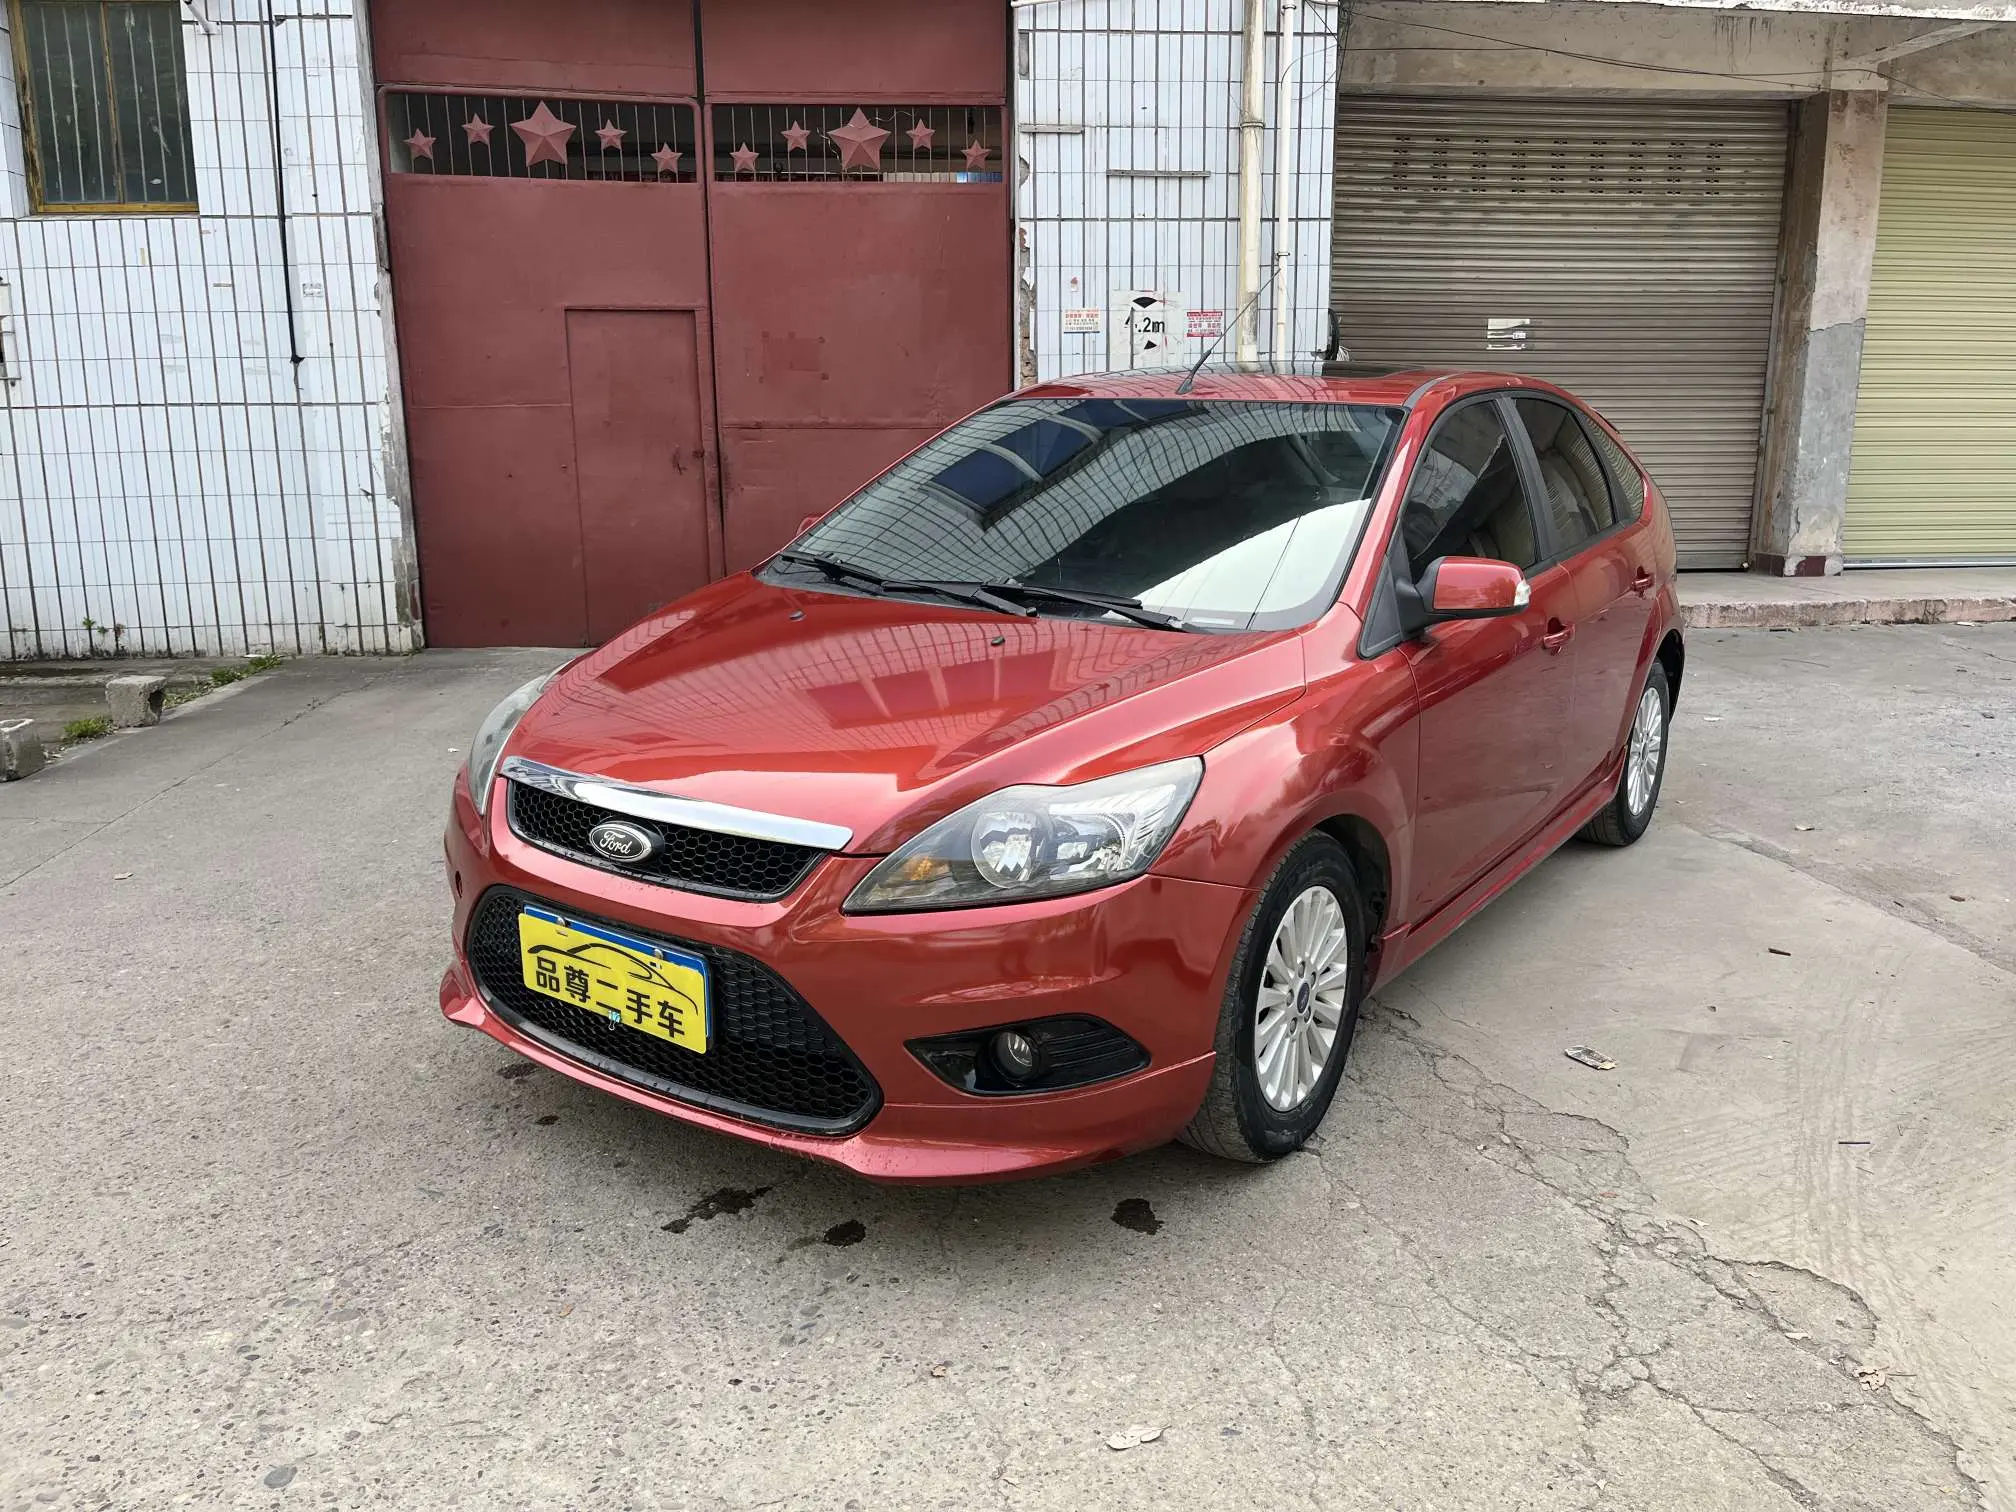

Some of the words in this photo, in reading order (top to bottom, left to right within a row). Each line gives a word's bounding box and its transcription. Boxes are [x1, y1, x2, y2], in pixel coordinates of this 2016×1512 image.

[599, 830, 632, 854] Ford
[536, 956, 685, 1038] 品尊二手车
